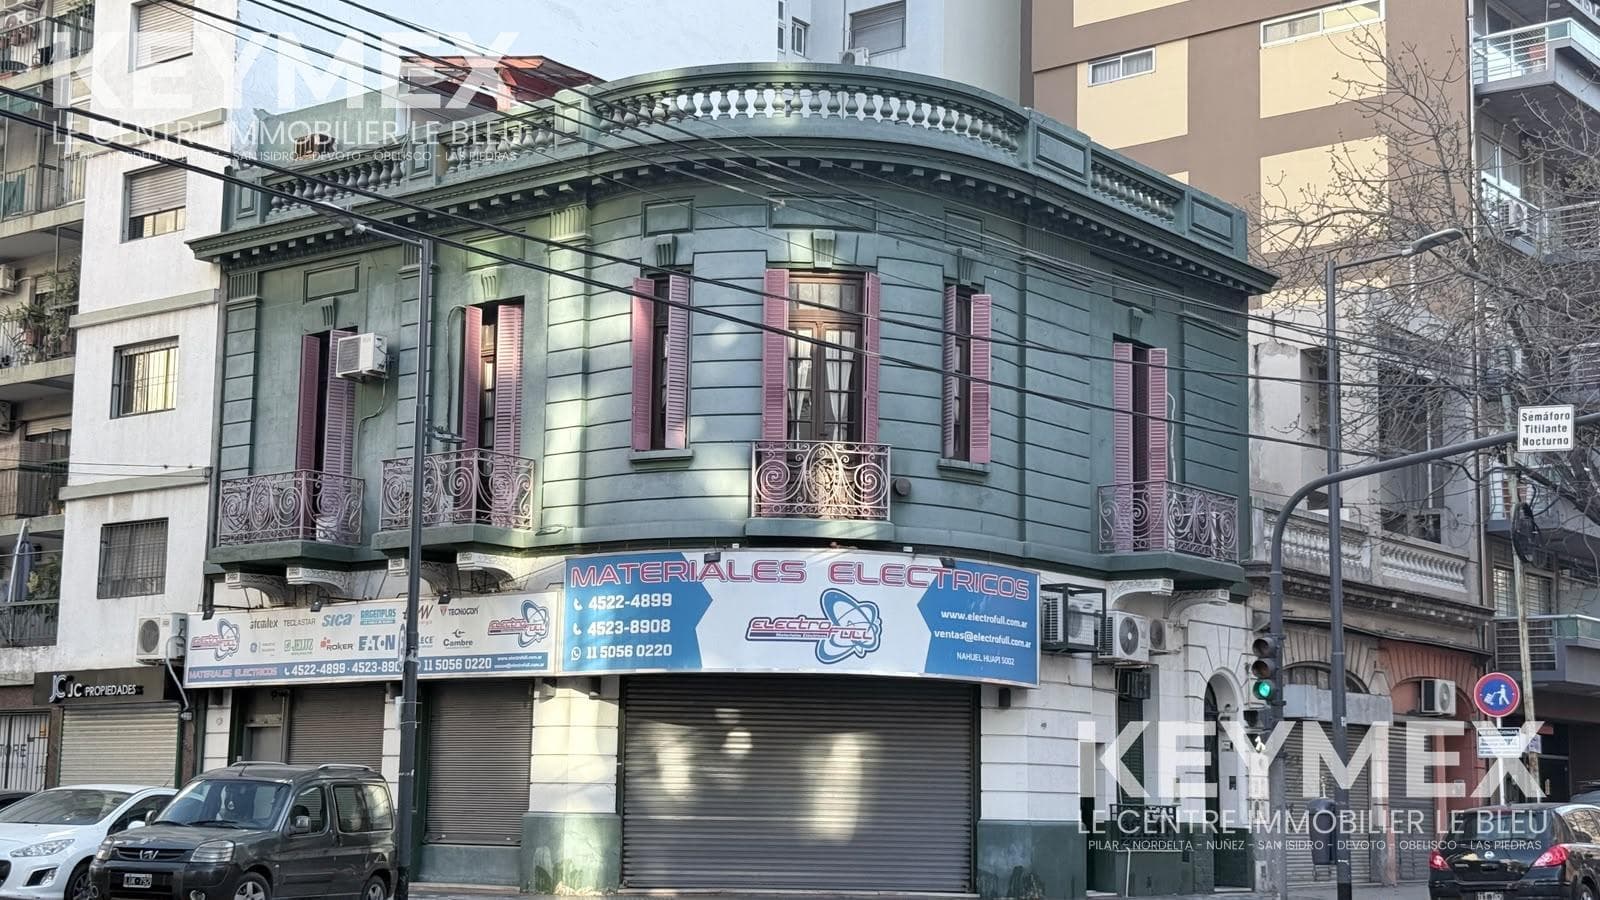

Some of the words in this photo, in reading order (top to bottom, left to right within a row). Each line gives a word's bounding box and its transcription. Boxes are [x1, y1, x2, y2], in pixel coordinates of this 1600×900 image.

[1521, 411, 1570, 422] Semáforo
[1524, 424, 1568, 434] Titilante
[1522, 436, 1569, 447] Nocturno
[570, 559, 807, 588] MATERIALES
[828, 560, 1030, 601] ELECTRICOS
[588, 592, 673, 610] 4522-4899
[283, 617, 316, 627] TECLASTAR
[940, 610, 1028, 629] www.electrofull.com.ar
[587, 619, 671, 636] 4523-8908
[358, 634, 396, 651] EATON
[443, 638, 473, 647] Cambre
[933, 629, 1032, 649] ventas@electrofull.com.ar
[586, 646, 598, 659] 11
[599, 645, 634, 658] 5056
[636, 643, 673, 658] 0220
[956, 651, 983, 663] NAHUEL
[983, 653, 1001, 665] HUAPI
[1001, 655, 1015, 666] 5002
[188, 668, 233, 679] MATERIALES
[234, 666, 277, 678] ELECTRICOS
[291, 663, 346, 676] 4522-4899
[351, 661, 402, 673] 4523-890
[423, 659, 433, 671] 11
[435, 659, 462, 671] 5056
[464, 657, 492, 670] 0220
[67, 683, 82, 698] JC
[84, 684, 137, 697] PROPIEDADES
